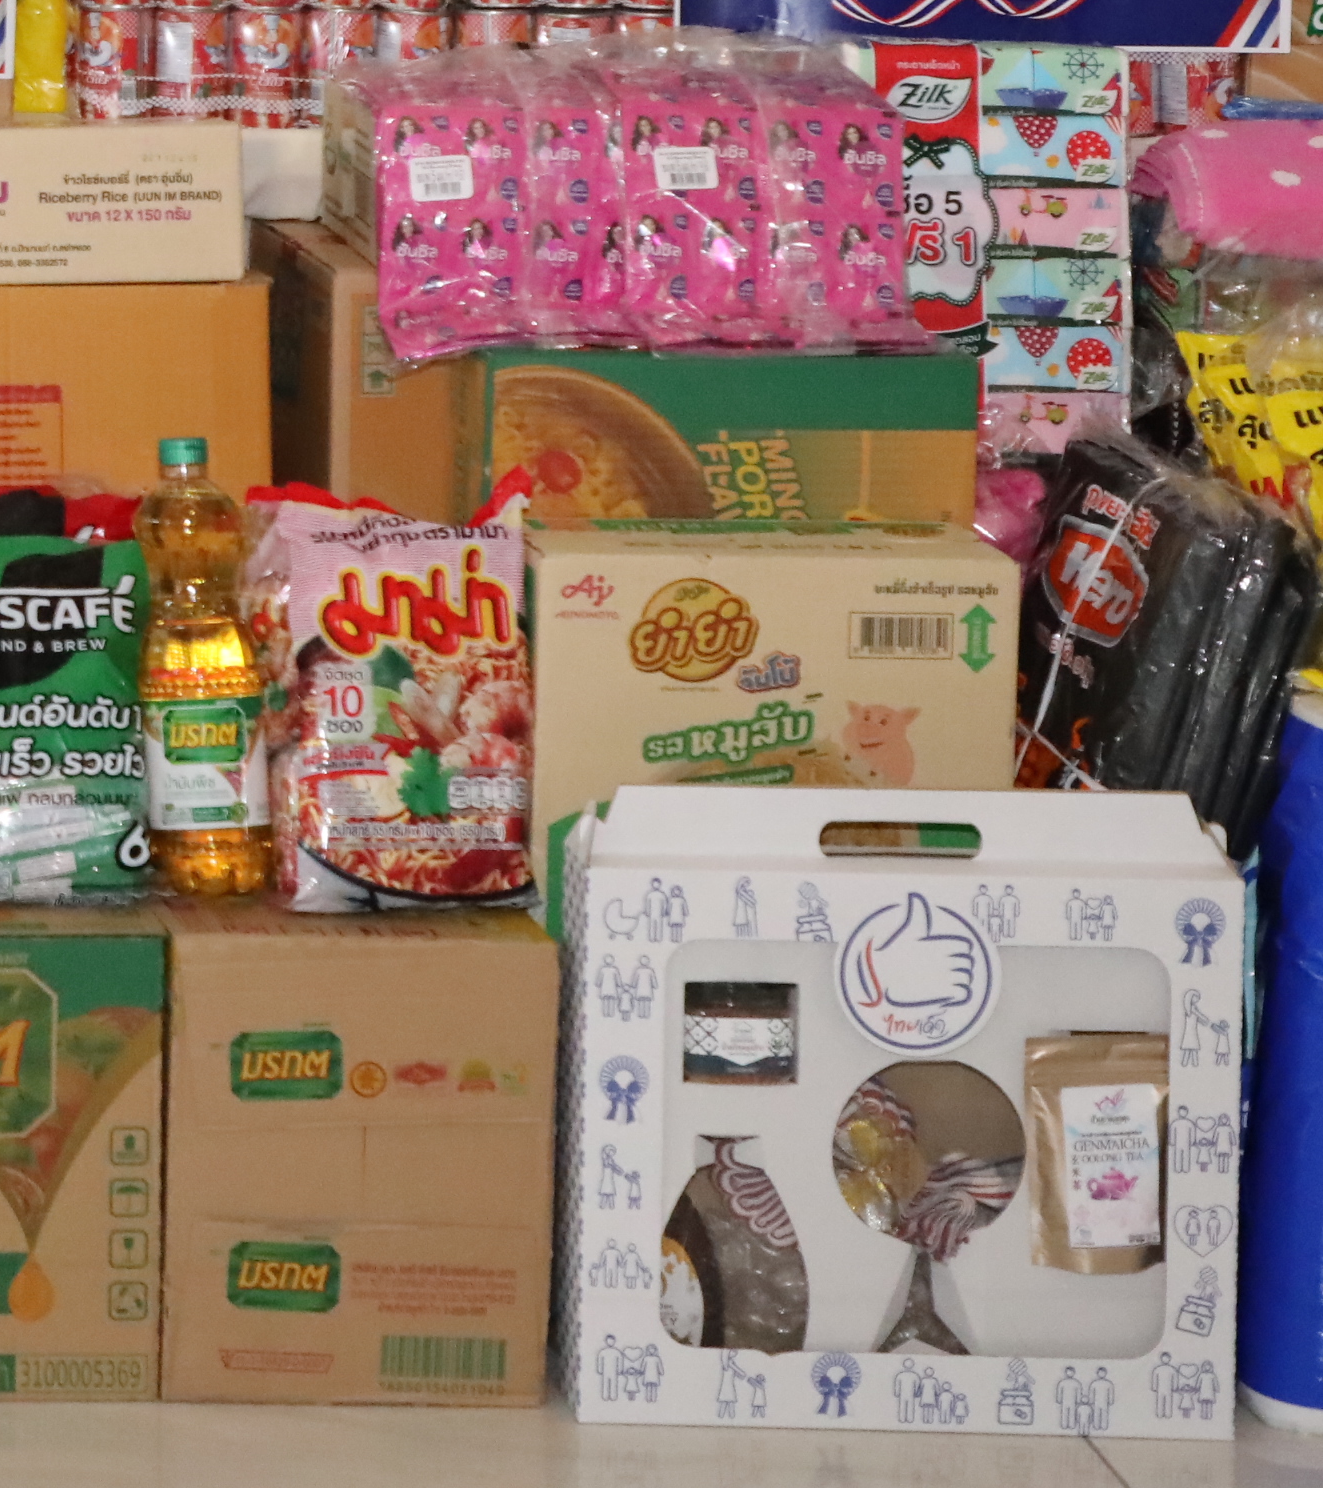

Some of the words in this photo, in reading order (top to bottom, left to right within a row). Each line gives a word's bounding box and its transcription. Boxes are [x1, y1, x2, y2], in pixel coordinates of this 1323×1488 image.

[898, 82, 954, 110] Zilk
[39, 190, 99, 206] Riceberry
[102, 190, 130, 204] Rice
[180, 190, 223, 205] BRAND)
[945, 190, 963, 216] 5
[67, 209, 102, 224] ขนาด
[105, 209, 122, 223] 12
[137, 209, 163, 222] 150
[954, 226, 977, 264] 1
[1059, 539, 1134, 625] Hero
[322, 548, 510, 656] มาม่า
[33, 639, 46, 654] &
[51, 636, 106, 653] BREW
[324, 666, 364, 685] จัดชุด
[323, 685, 365, 718] 10
[169, 722, 238, 749] มรกต
[325, 719, 364, 734] ซอง
[63, 745, 146, 780] รวยไว
[240, 1049, 332, 1082] มรกต
[1073, 1138, 1150, 1152] GENMAICHA
[1081, 1153, 1123, 1163] OOLONG
[1126, 1152, 1144, 1162] TEA
[237, 1260, 329, 1292] มรกต
[19, 1359, 142, 1389] 3100005369
